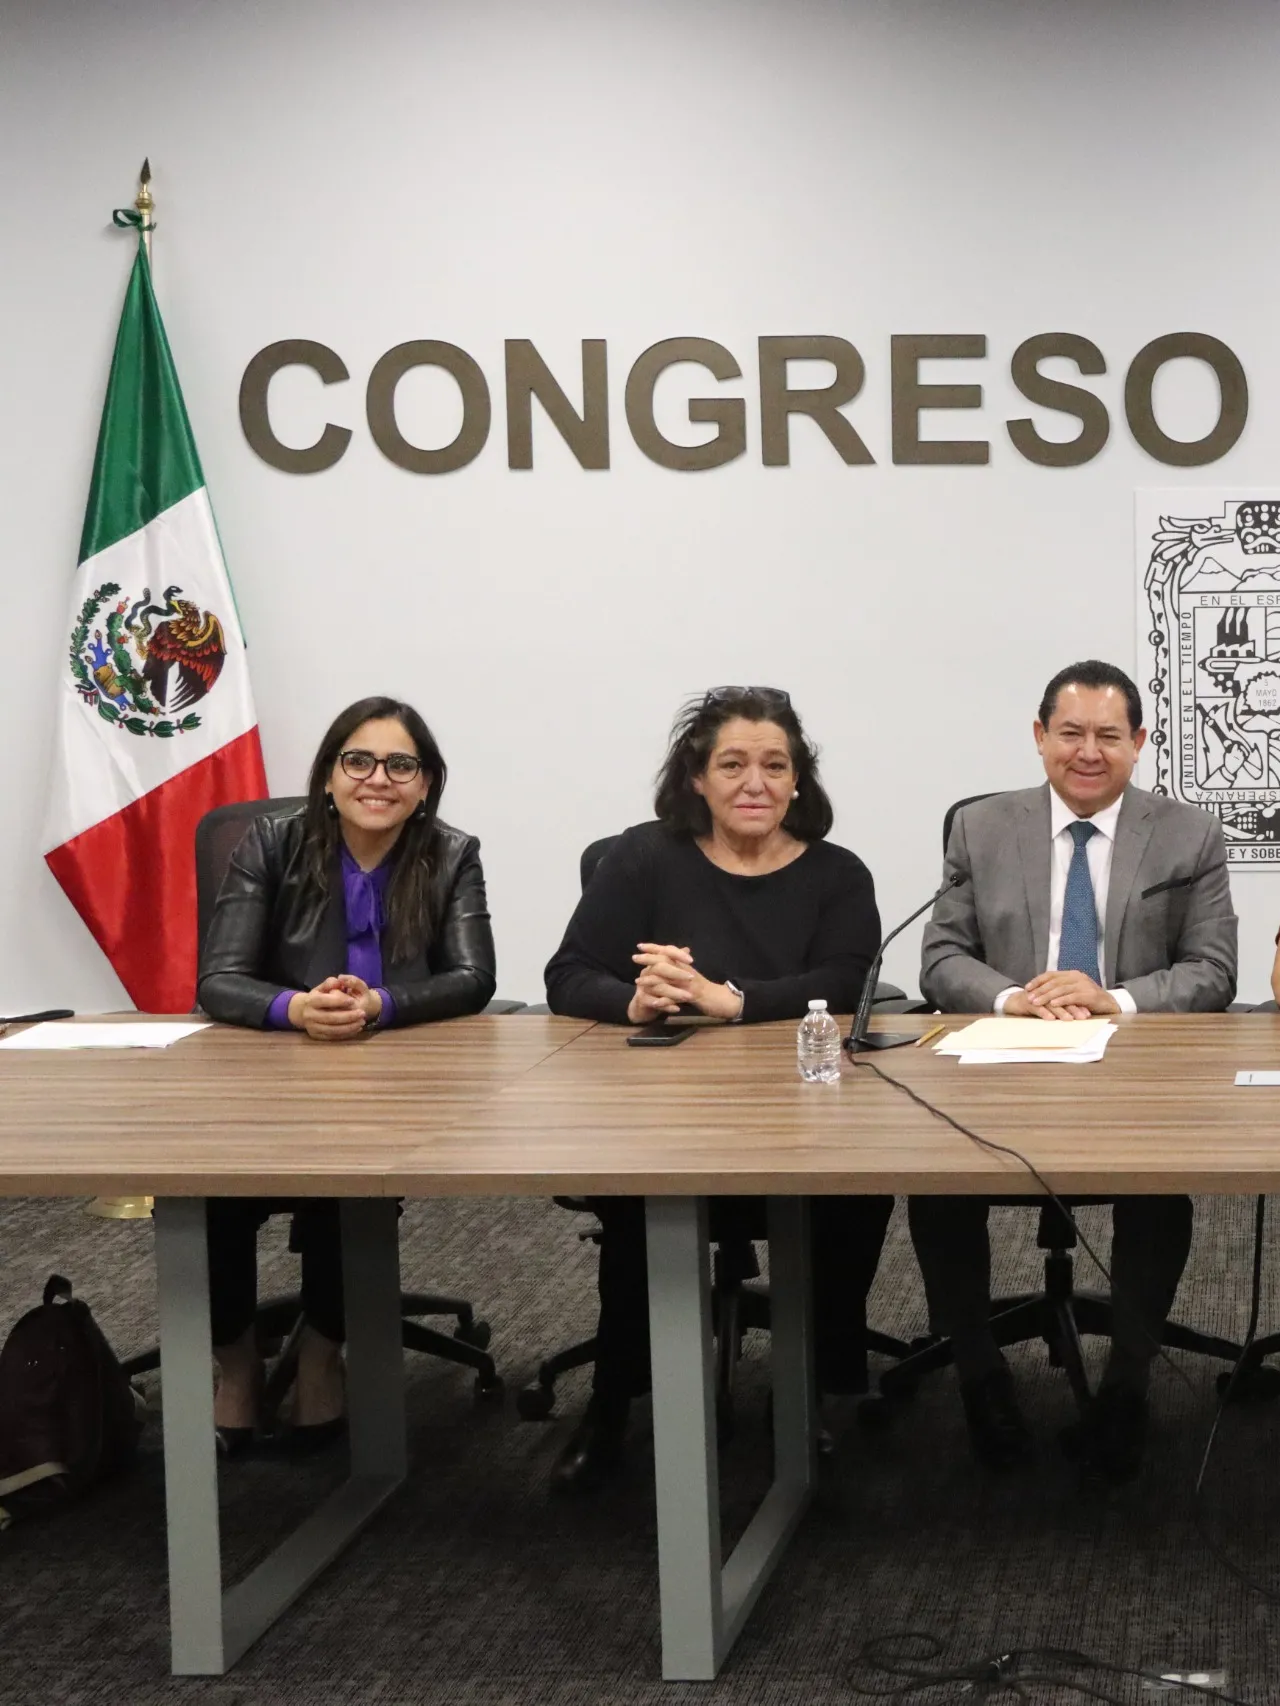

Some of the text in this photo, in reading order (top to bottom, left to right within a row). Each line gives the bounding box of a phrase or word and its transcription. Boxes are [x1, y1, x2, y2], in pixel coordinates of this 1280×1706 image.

[238, 335, 1249, 475] CONGRESO
[1200, 595, 1221, 605] EN
[1230, 595, 1246, 605] EL
[1255, 689, 1277, 697] MAYO
[1181, 611, 1194, 788] UNIDOS EN EL TIEMPO
[1258, 699, 1277, 707] 1862
[1239, 848, 1247, 859] Y
